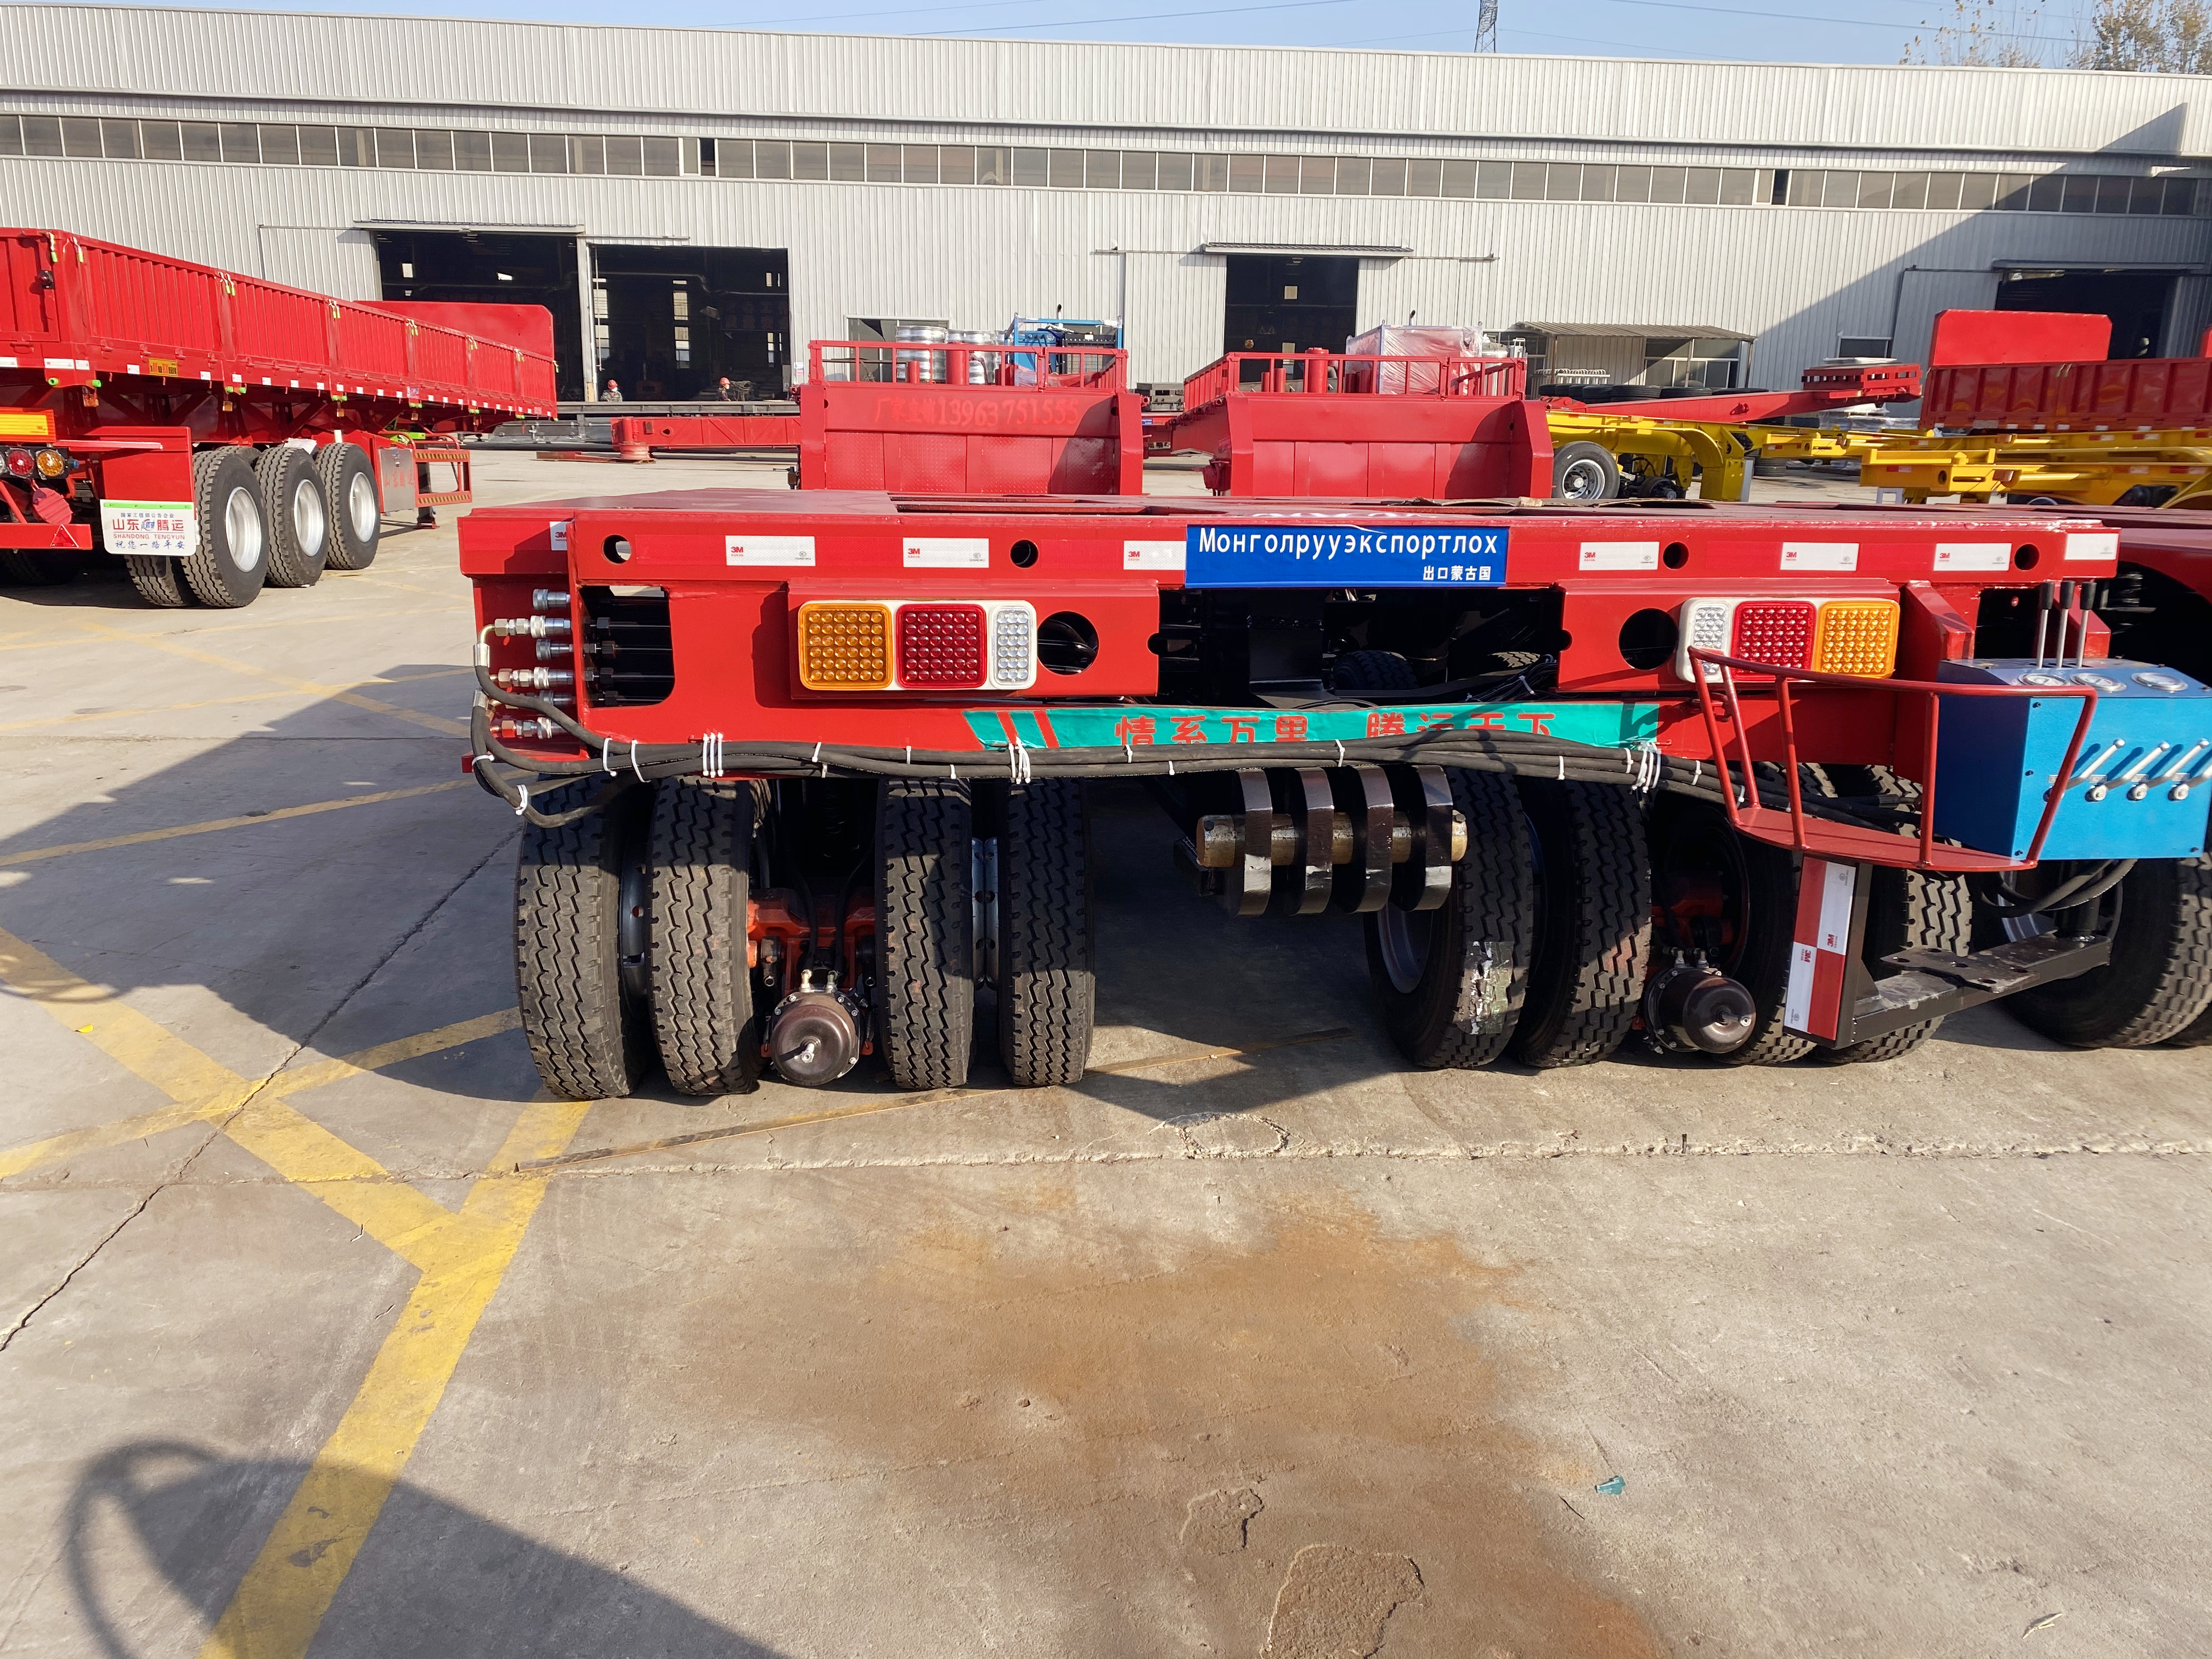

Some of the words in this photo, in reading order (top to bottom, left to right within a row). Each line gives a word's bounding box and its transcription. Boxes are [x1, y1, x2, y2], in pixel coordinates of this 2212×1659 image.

[1199, 527, 1498, 560] Монголрууэкспортлох
[1423, 565, 1492, 581] 出口蒙古国
[1827, 934, 1835, 947] 3M
[1804, 950, 1812, 963] 3M
